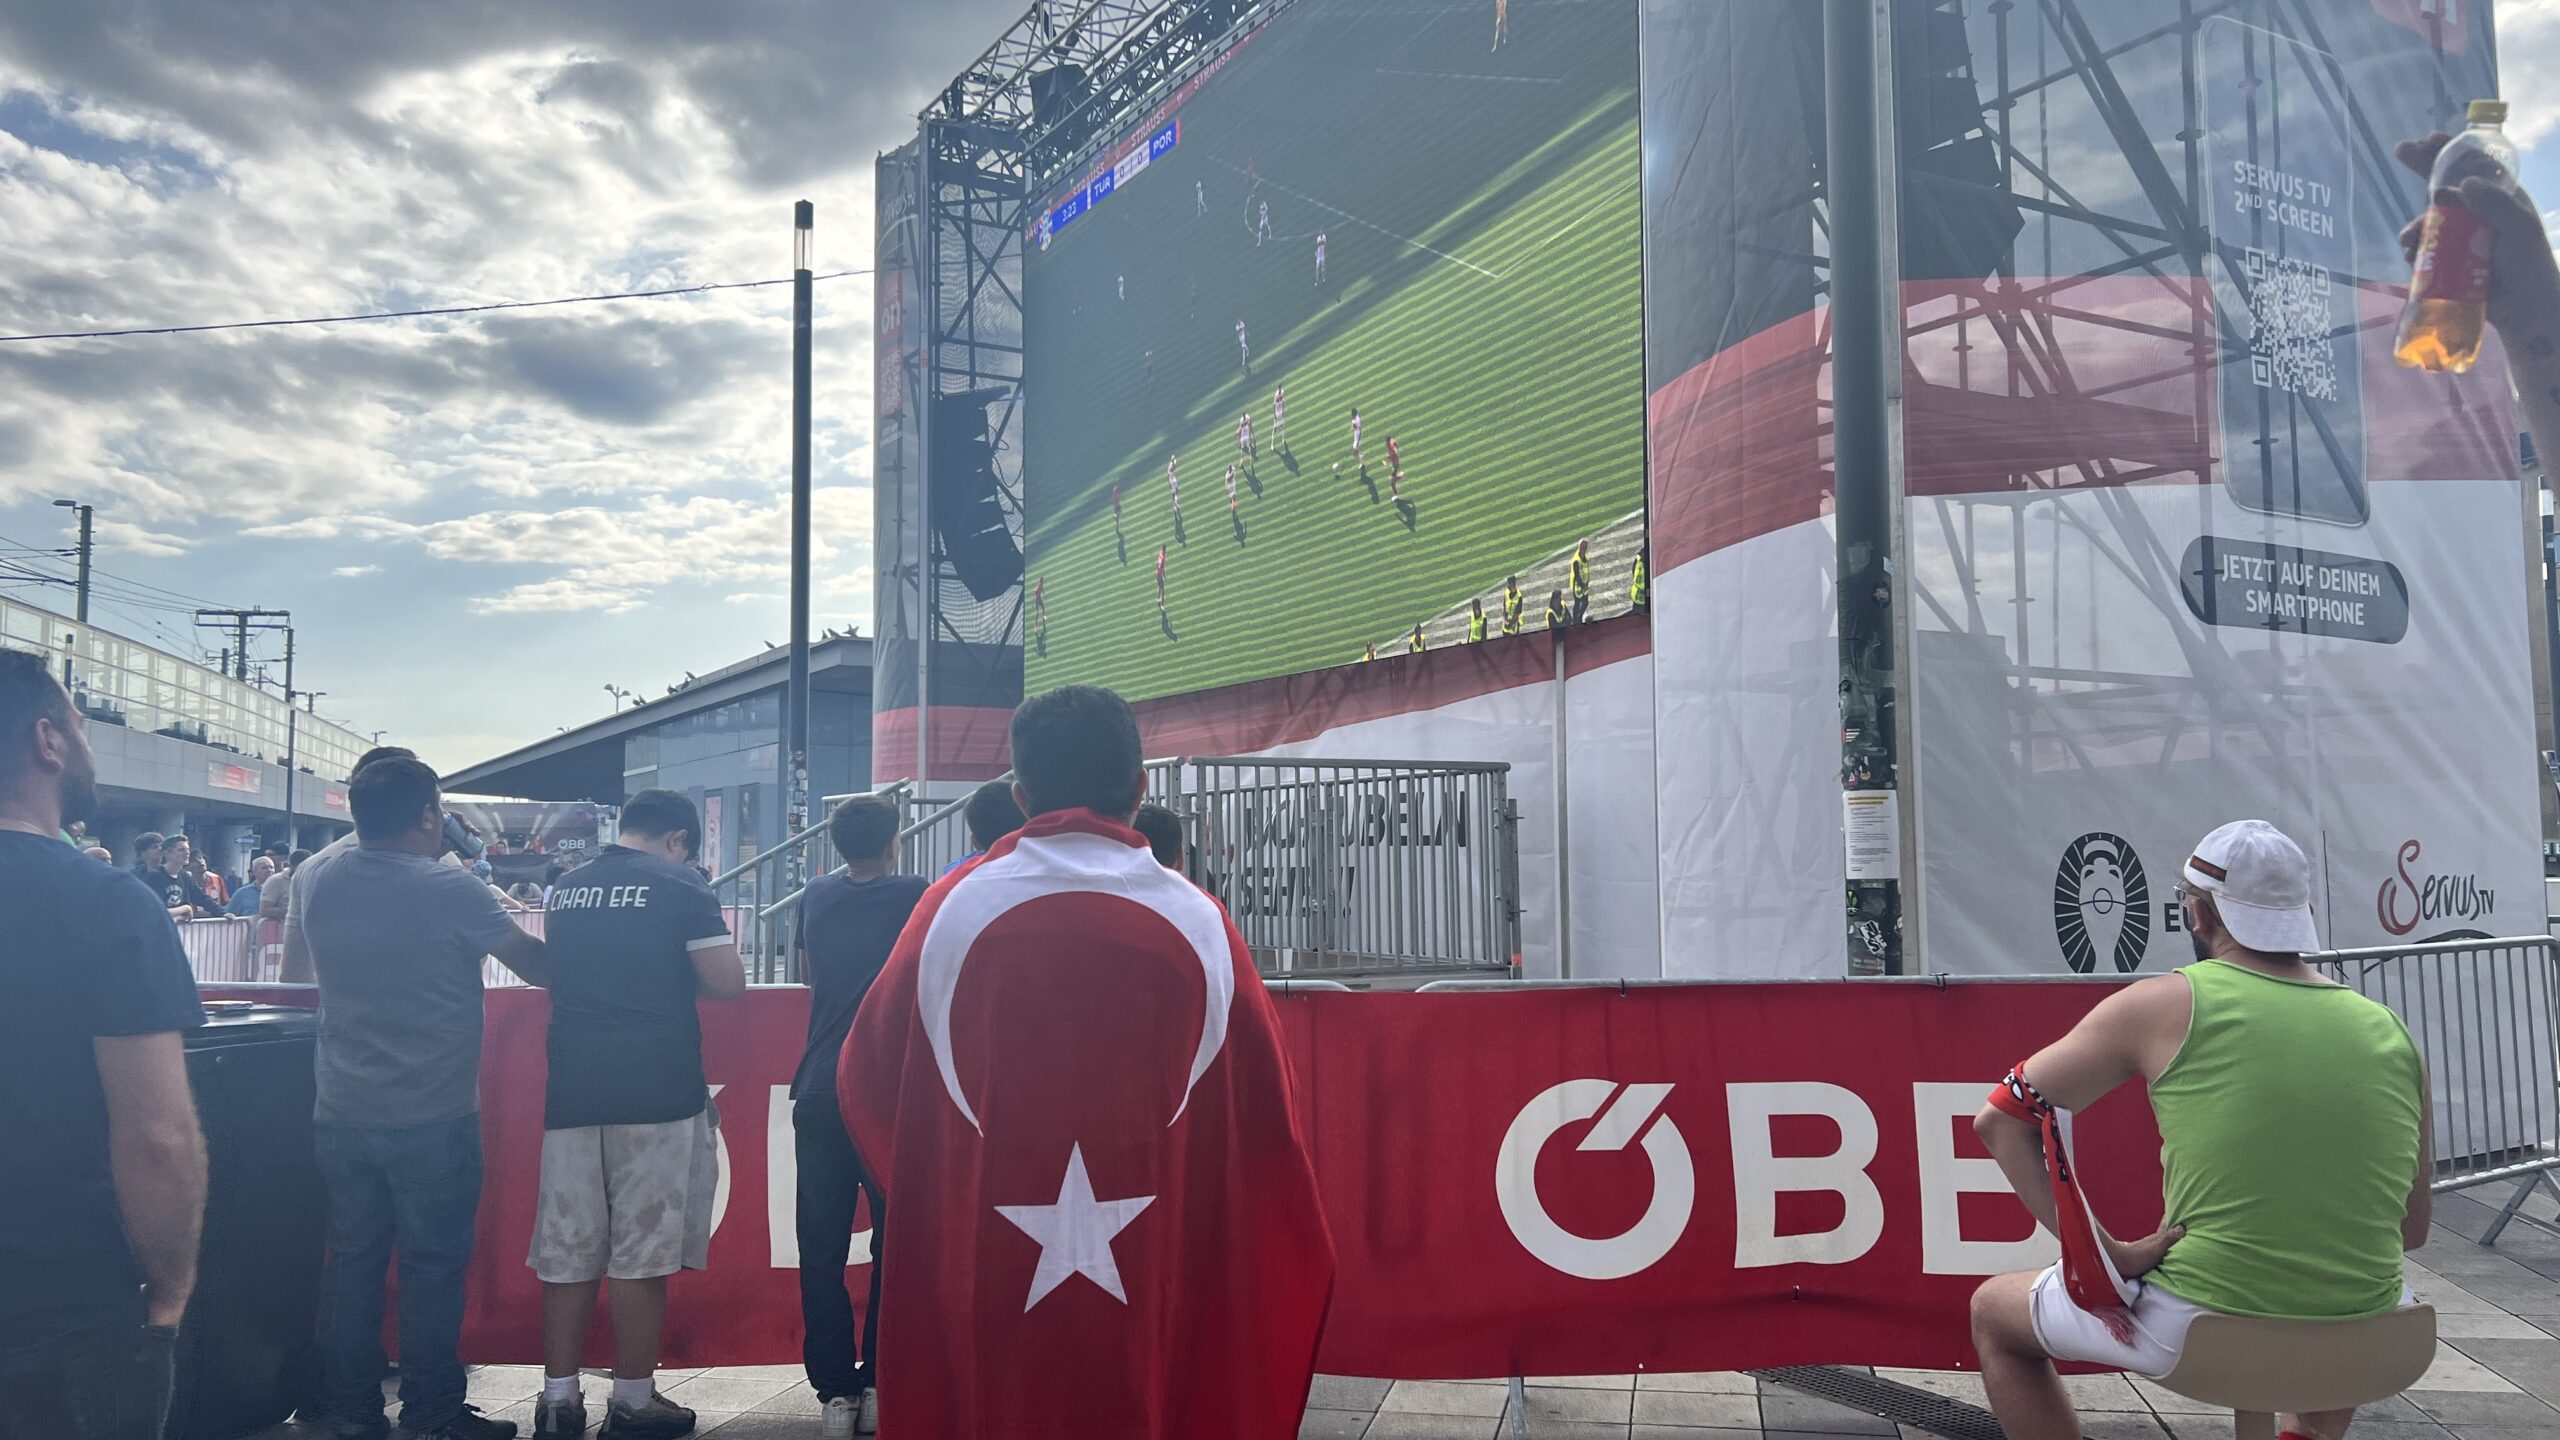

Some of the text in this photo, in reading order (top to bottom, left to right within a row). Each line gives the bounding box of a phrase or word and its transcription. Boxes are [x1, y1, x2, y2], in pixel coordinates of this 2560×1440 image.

[1131, 106, 1166, 148] STRAUSS
[1094, 176, 1111, 197] TUR
[1153, 129, 1172, 154] POR
[2234, 160, 2331, 208] SERVUS TV
[2234, 190, 2334, 239] 2ND SCREEN
[2221, 553, 2381, 597] JETZT AUF DEINEM
[2246, 589, 2365, 626] SMARTPHONE
[550, 886, 650, 912] CIHAN EFE
